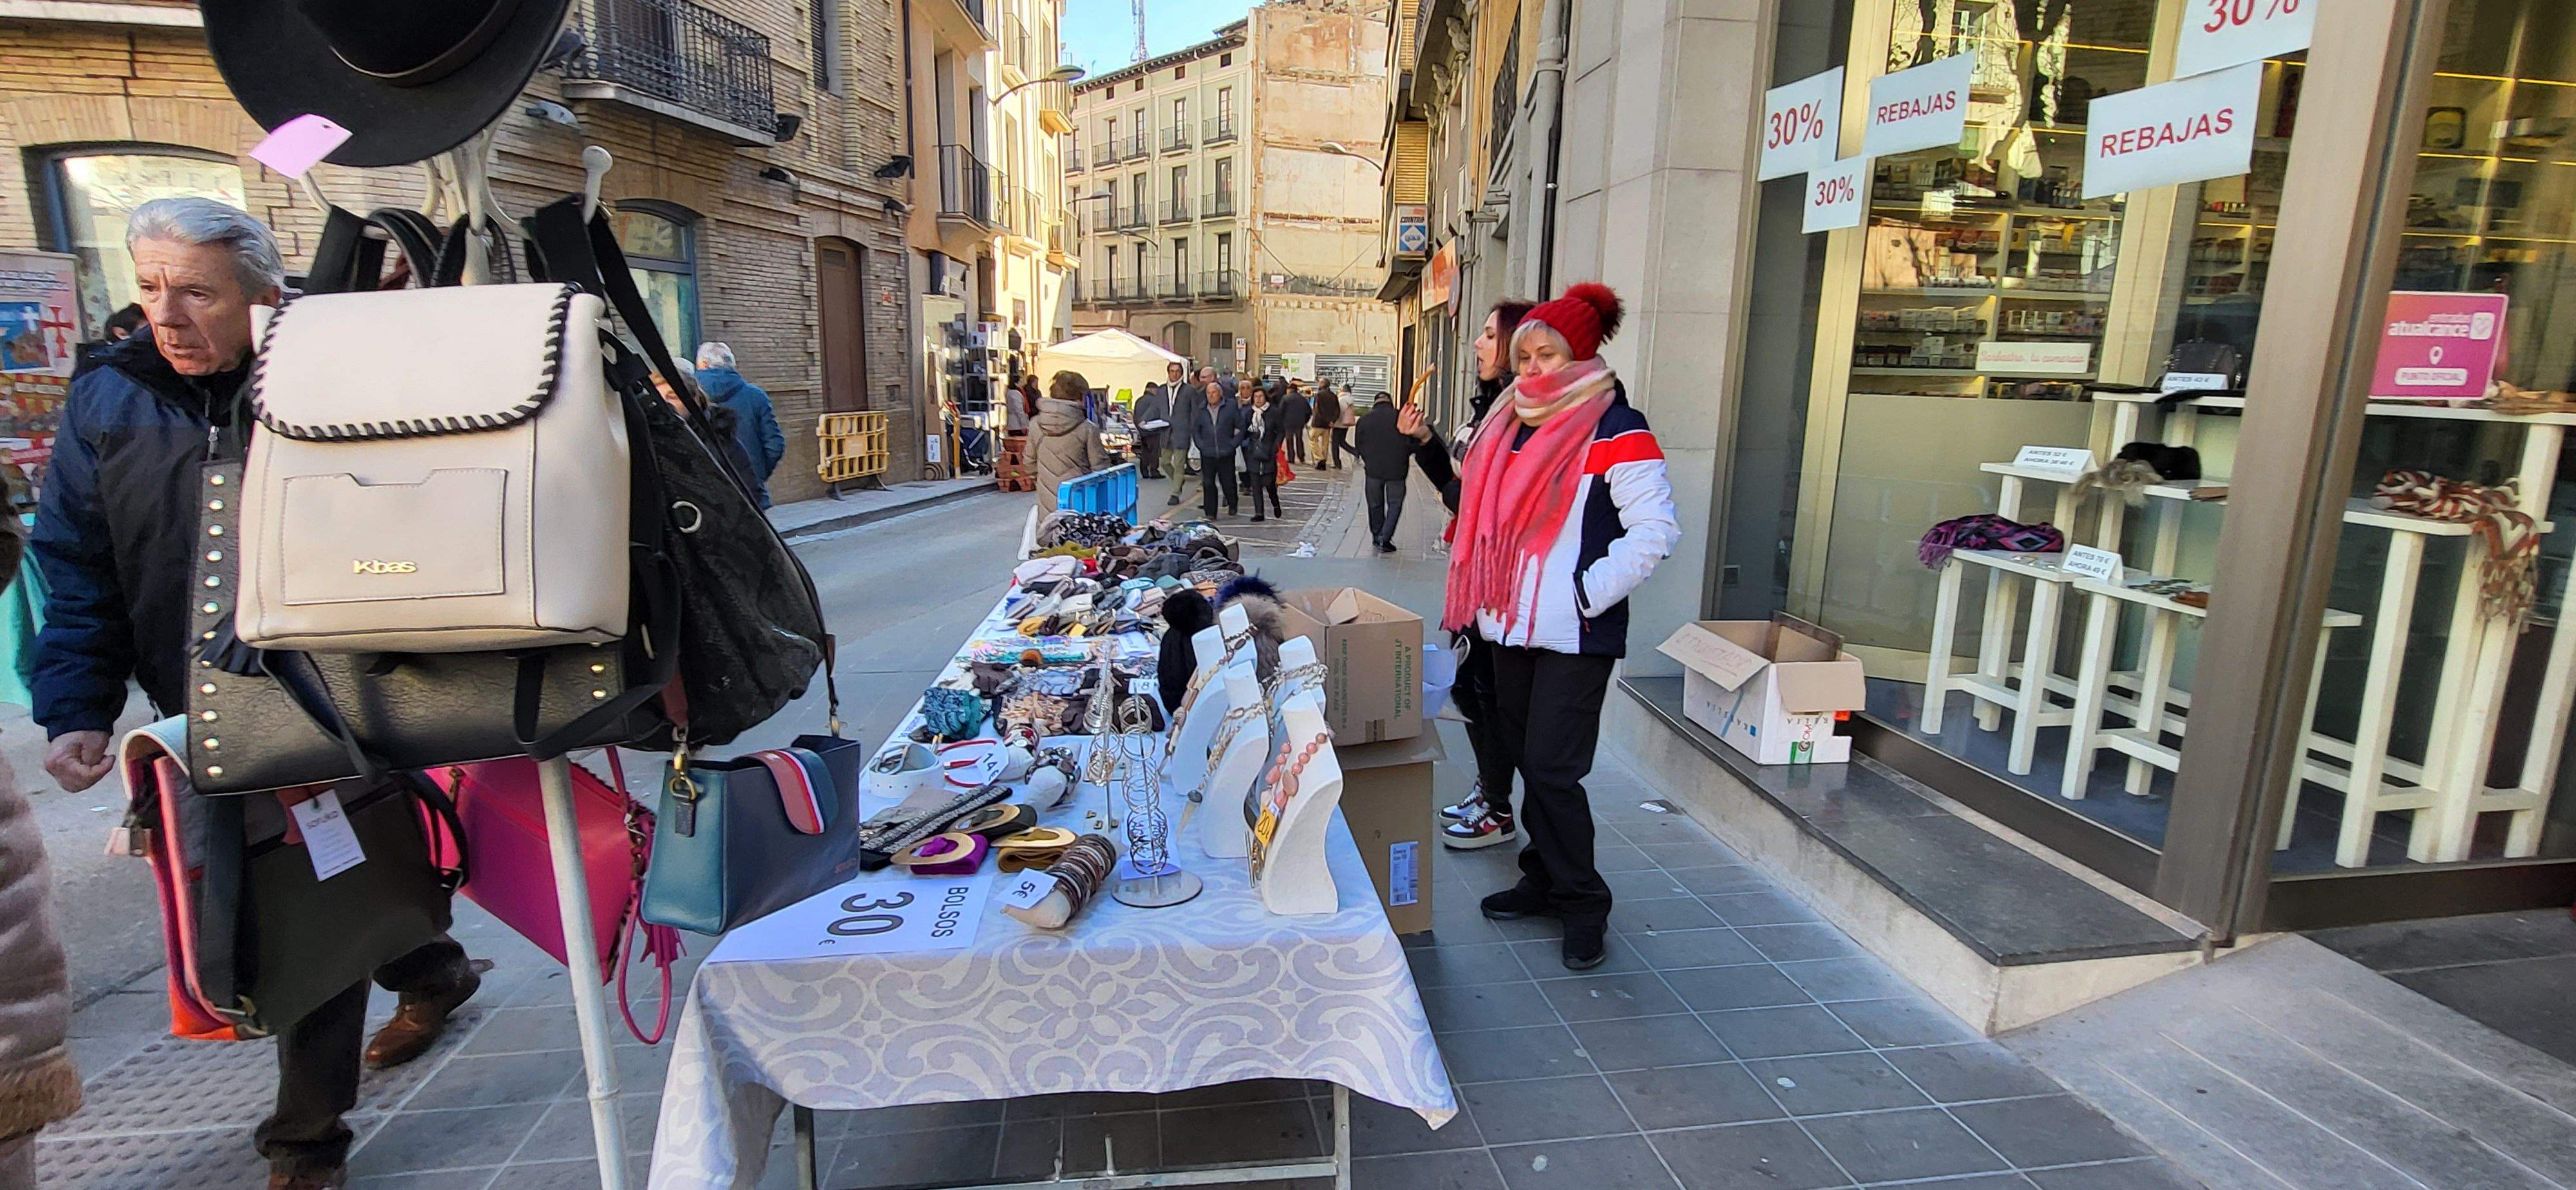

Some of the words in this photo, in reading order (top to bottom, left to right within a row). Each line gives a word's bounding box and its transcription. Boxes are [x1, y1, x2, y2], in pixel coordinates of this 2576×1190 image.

[1877, 90, 1956, 126] REBAJAS
[1768, 99, 1823, 149] 30%
[2099, 108, 2233, 158] REBAJAS
[1815, 175, 1854, 206] 30%
[352, 560, 417, 574] Kbas
[2068, 561, 2092, 571] AHORA
[2072, 550, 2096, 560] ANTES
[1395, 638, 1402, 648] JT
[1404, 698, 1411, 710] OF
[1012, 881, 1036, 899] 5€
[827, 892, 915, 936] 30
[931, 887, 970, 938] BOLSOS
